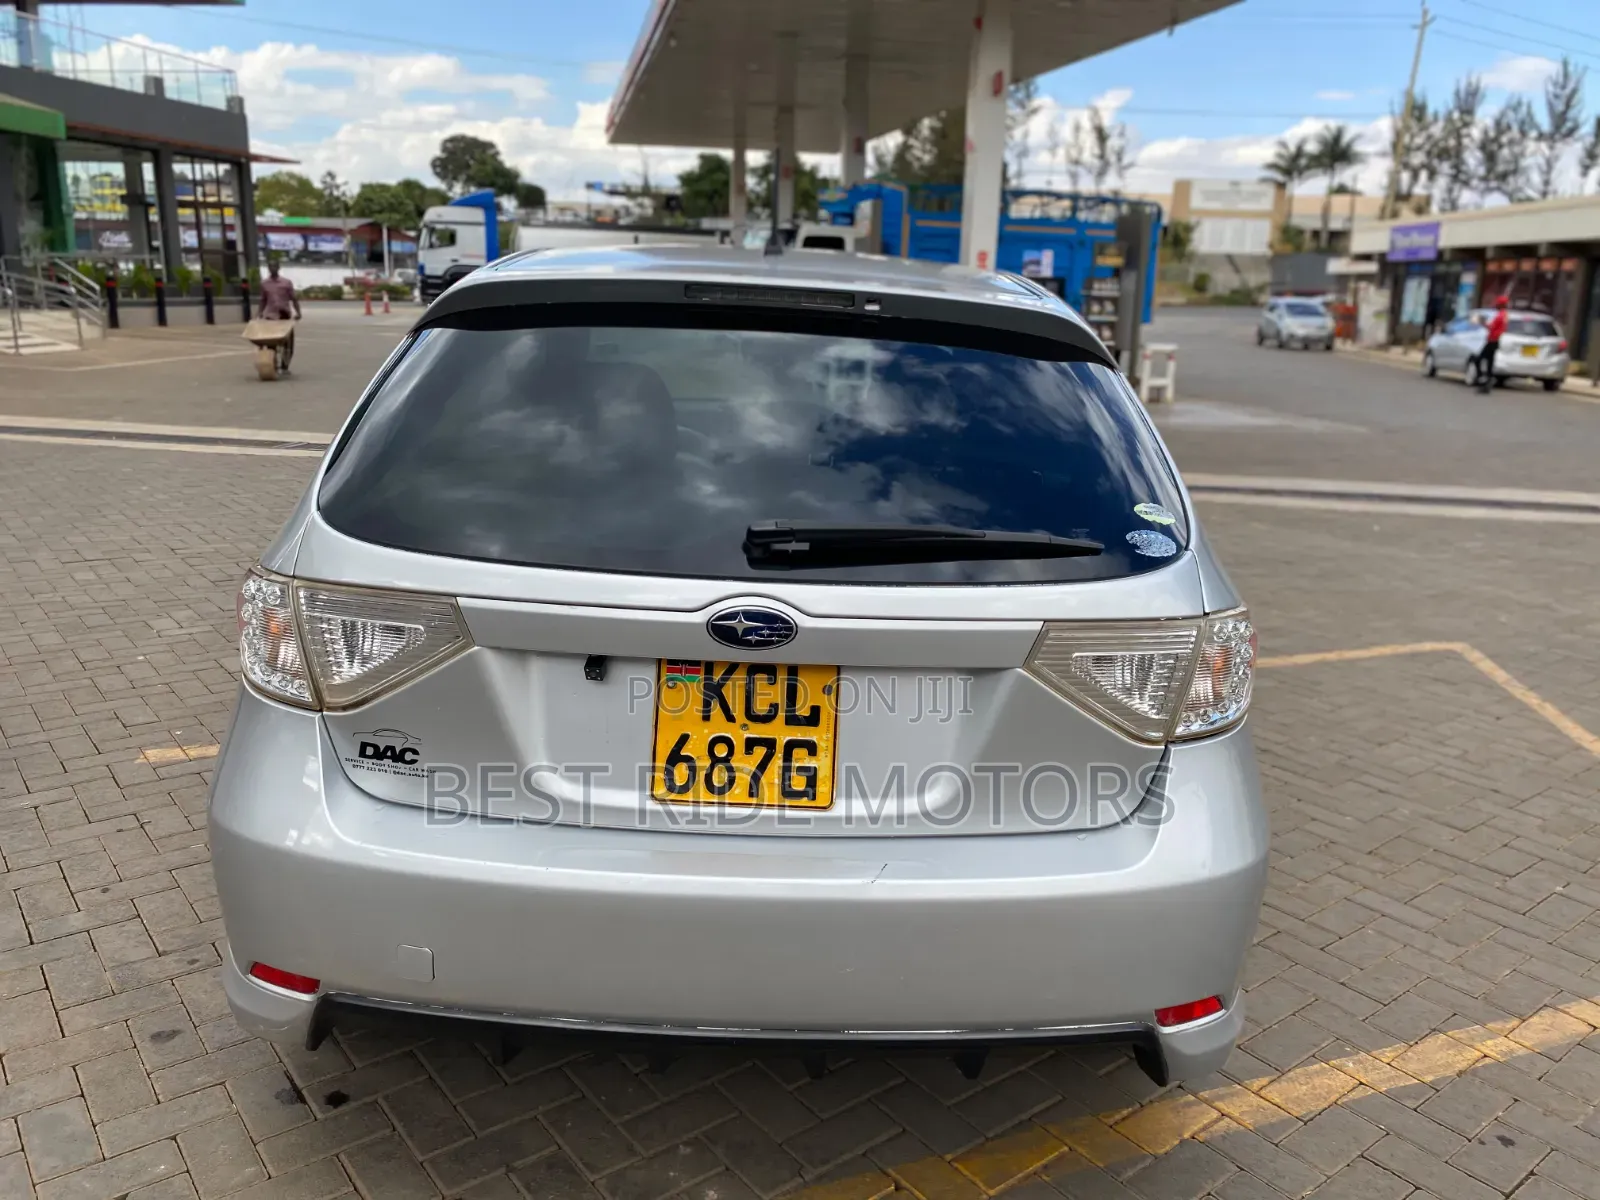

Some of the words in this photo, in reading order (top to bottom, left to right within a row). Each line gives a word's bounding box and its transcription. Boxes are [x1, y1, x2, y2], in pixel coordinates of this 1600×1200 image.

[701, 661, 821, 727] KCL
[358, 741, 420, 765] DAC
[664, 732, 819, 801] 687G
